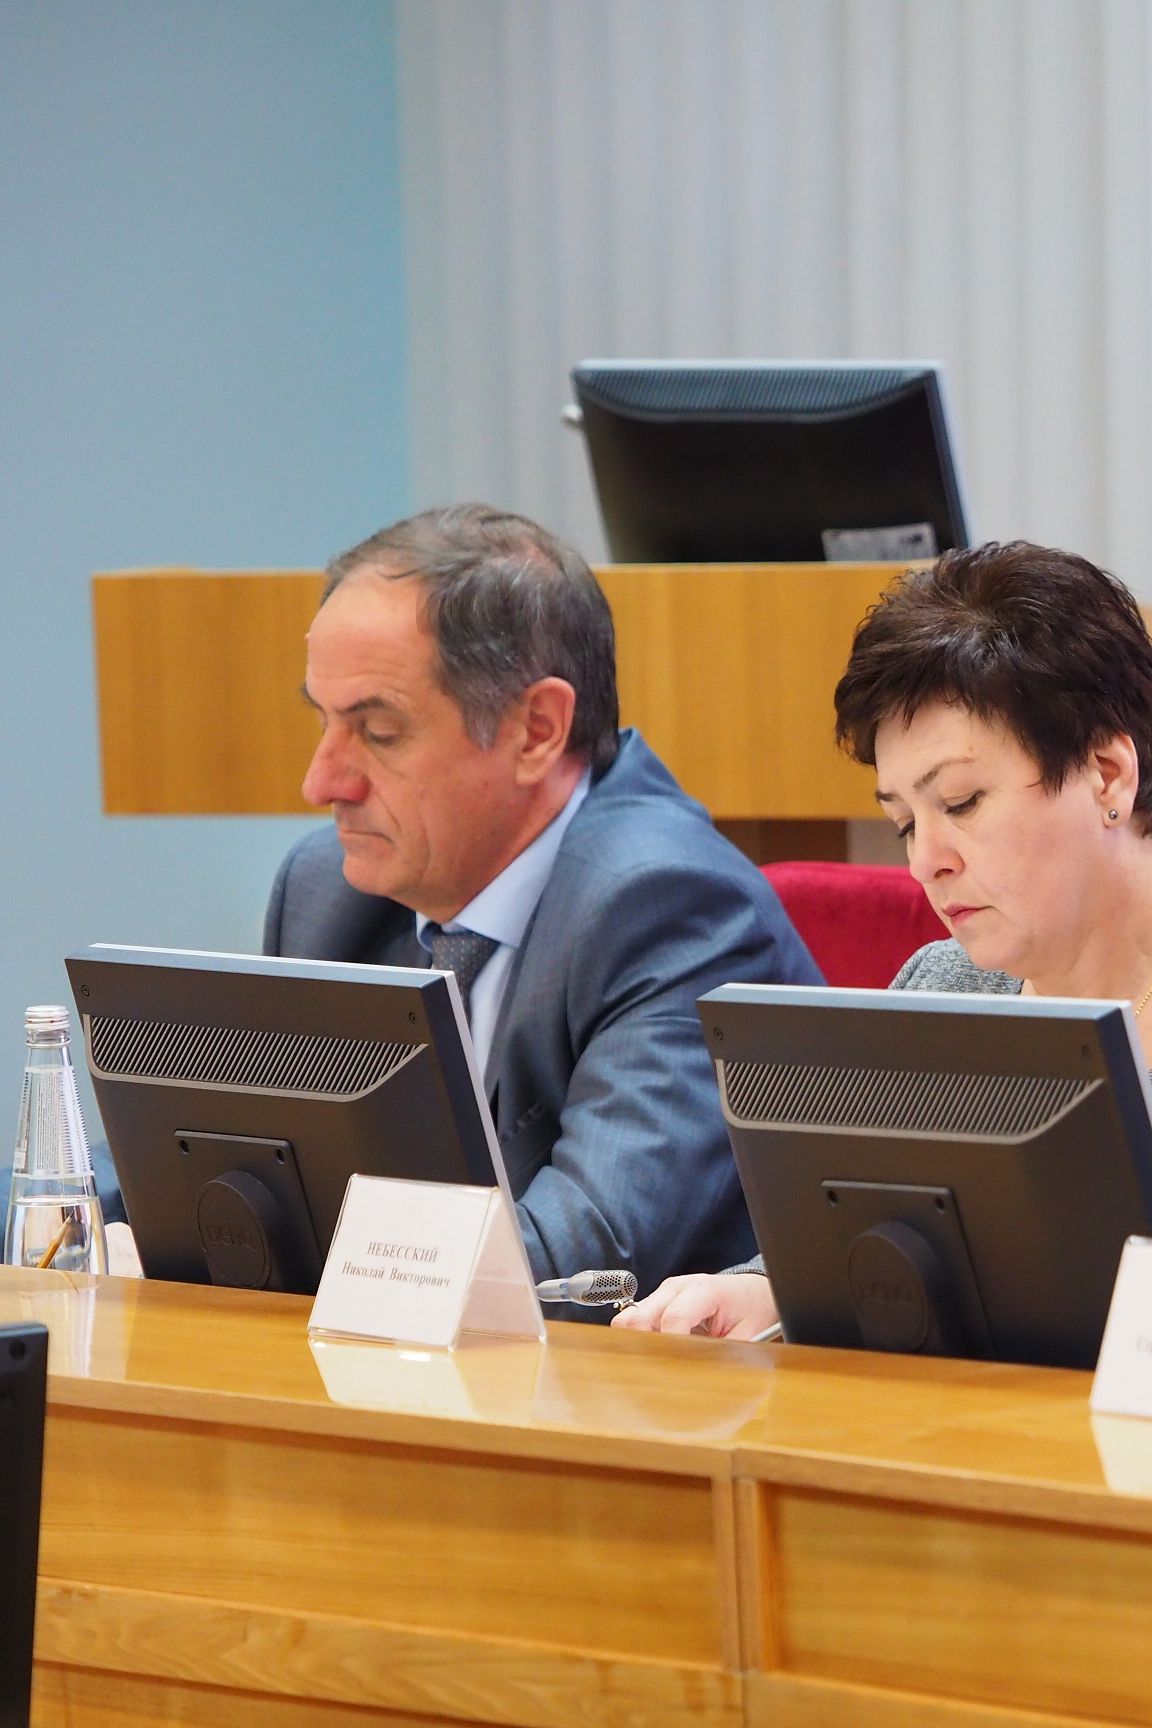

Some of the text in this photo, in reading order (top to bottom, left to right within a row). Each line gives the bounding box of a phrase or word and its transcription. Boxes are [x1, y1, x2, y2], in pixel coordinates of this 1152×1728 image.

[366, 1241, 438, 1263] НЕБЕССКИЙ
[341, 1261, 451, 1288] Николай Викторович
